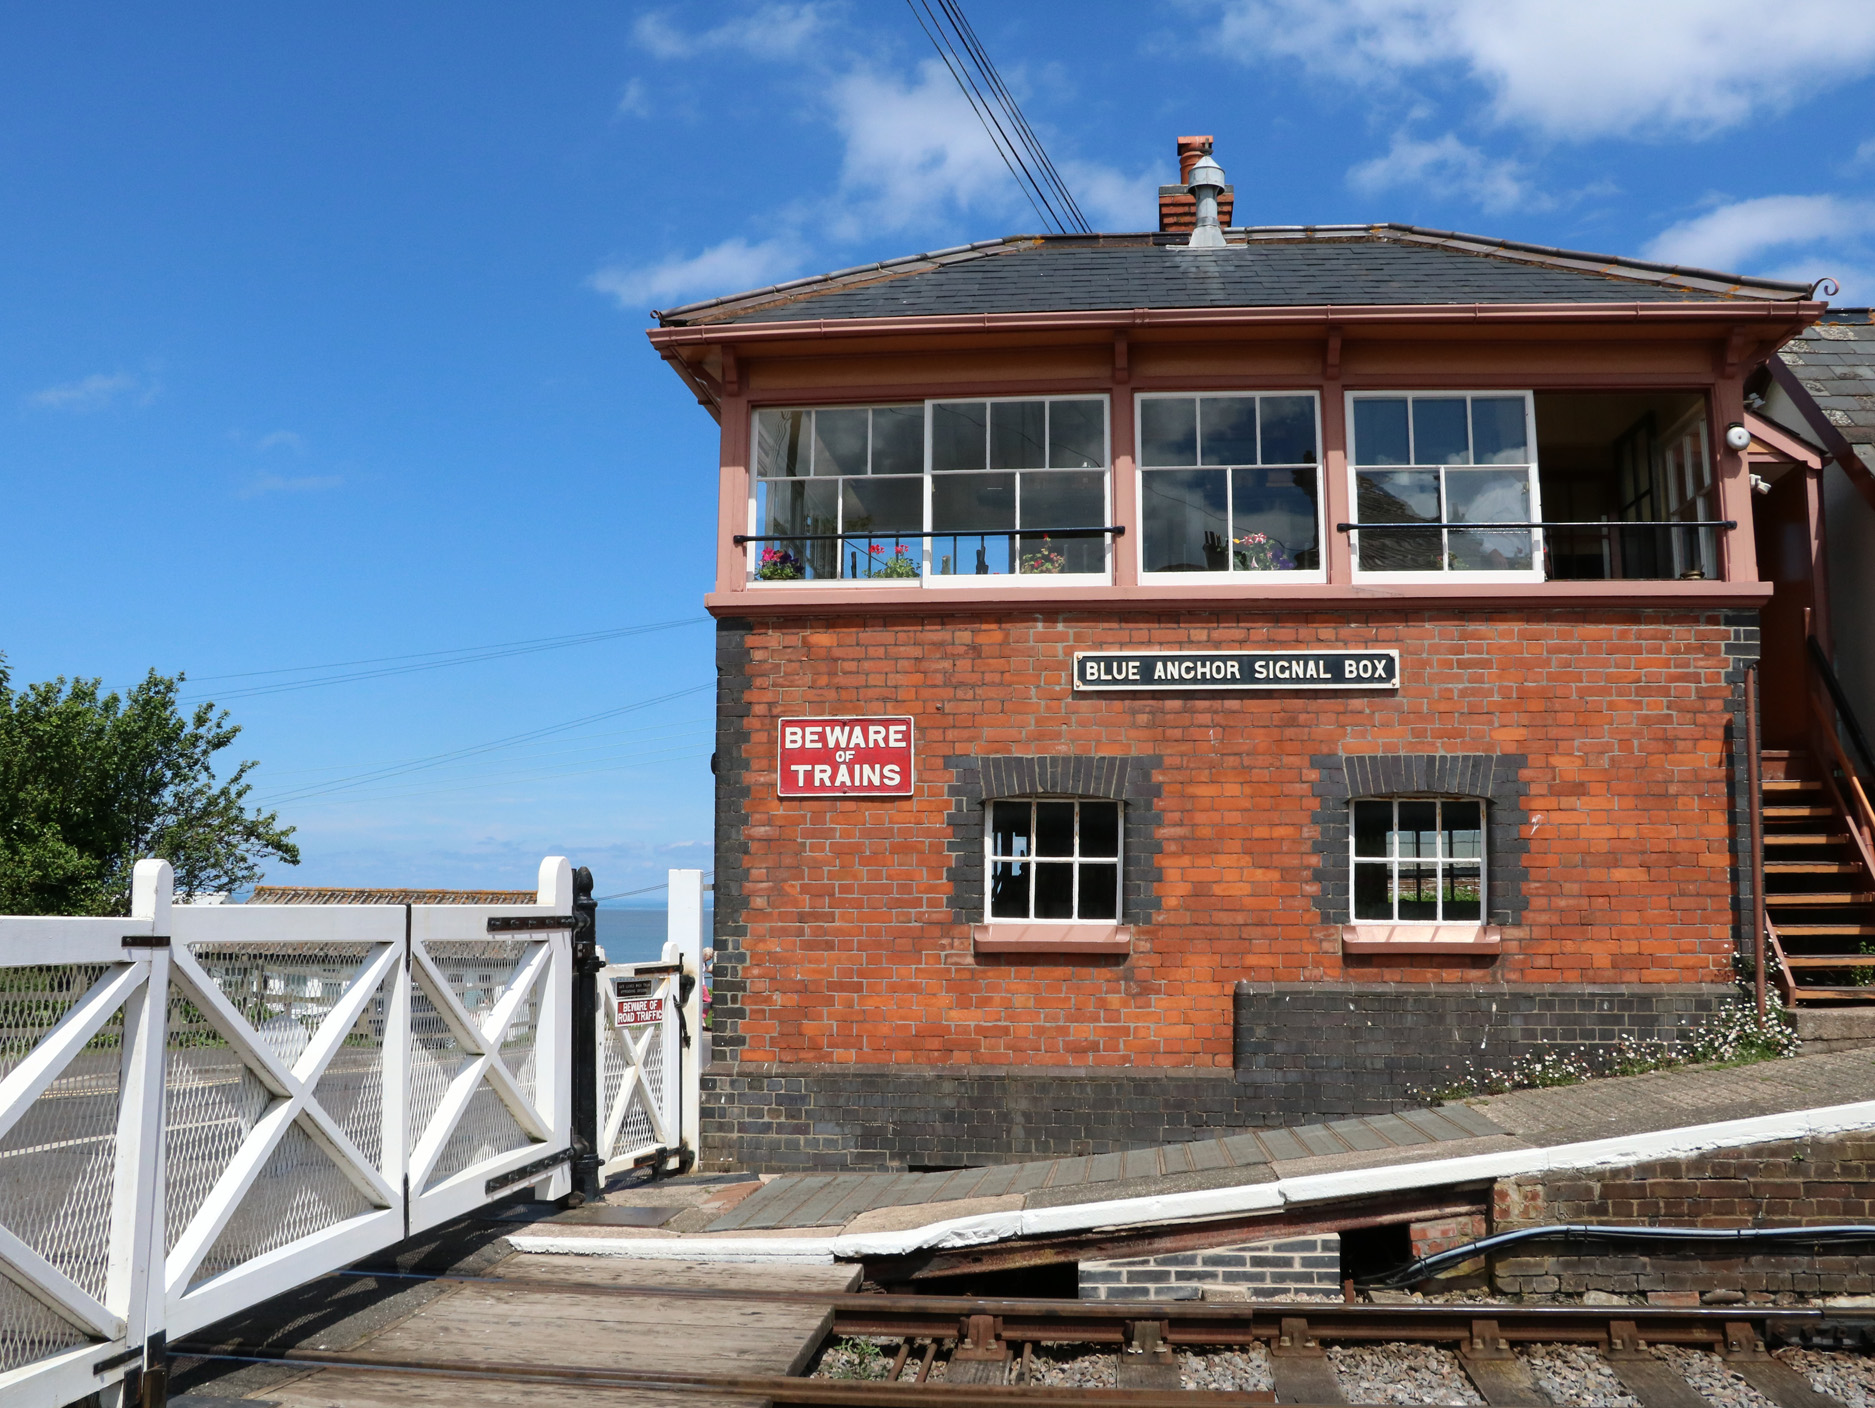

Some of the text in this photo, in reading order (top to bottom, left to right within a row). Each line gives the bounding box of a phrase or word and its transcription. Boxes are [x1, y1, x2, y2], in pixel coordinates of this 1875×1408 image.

[1086, 659, 1387, 680] BLUE ANCHOR SIGNAL BOX
[785, 725, 907, 749] BEWARE
[835, 750, 855, 763] OF
[790, 764, 901, 787] TRAINS
[623, 1000, 658, 1012] BEWARE OF
[618, 1010, 663, 1023] ROAD TRAFFIC
